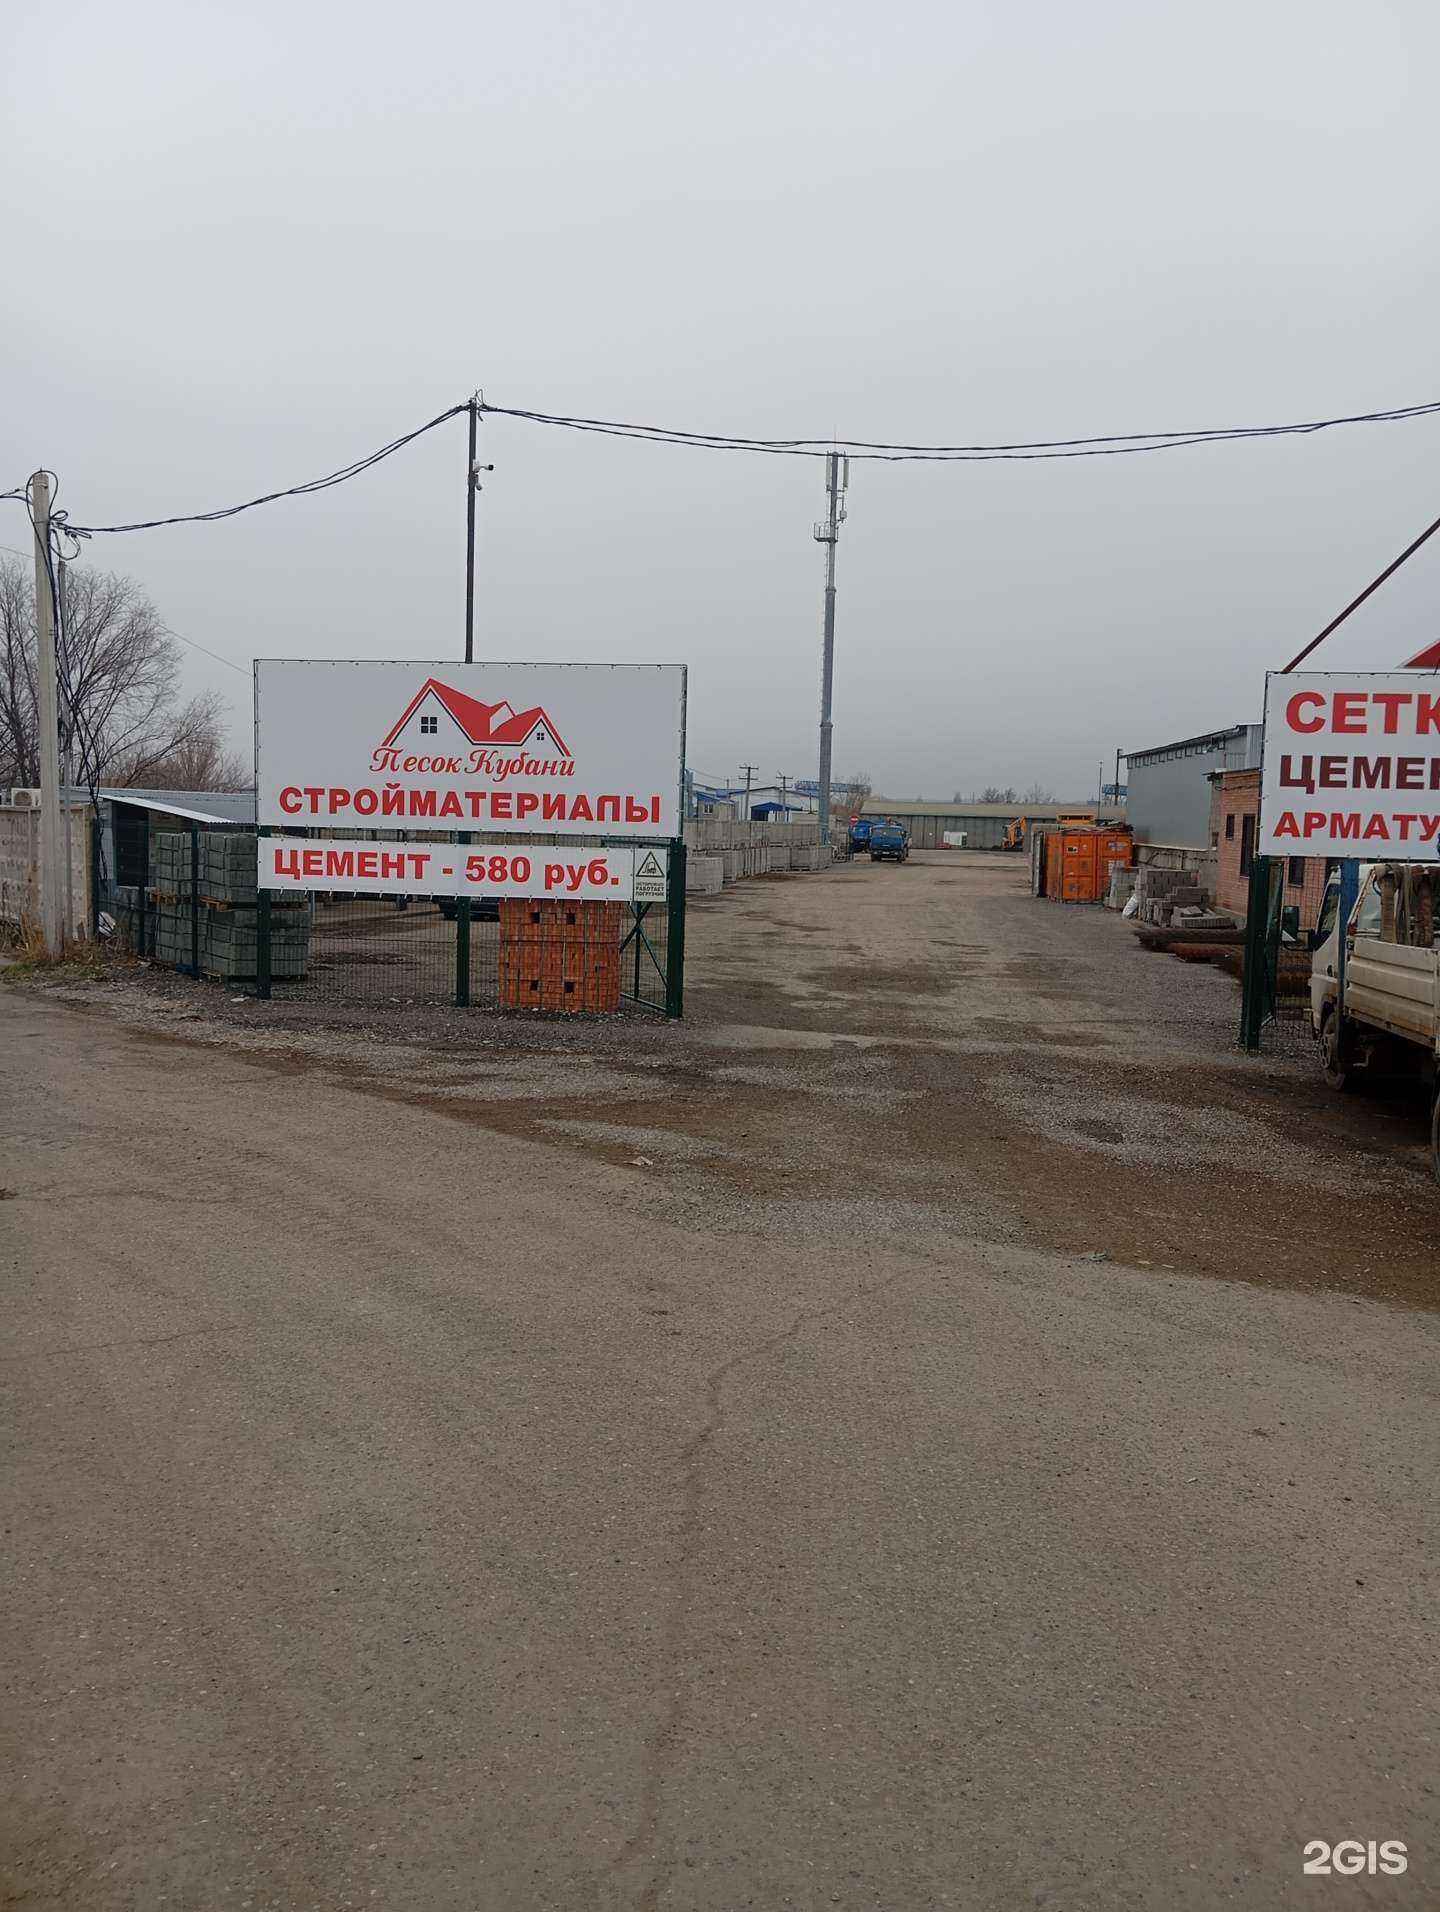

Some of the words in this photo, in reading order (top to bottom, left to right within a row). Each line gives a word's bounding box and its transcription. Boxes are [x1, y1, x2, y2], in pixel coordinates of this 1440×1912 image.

[1286, 691, 1440, 734] СЕТК
[369, 747, 461, 773] Песок
[465, 749, 575, 783] Кубани
[279, 783, 660, 823] СТРОЙМАТЕРИАЛЫ
[1273, 811, 1440, 841] АРМАТУ
[275, 849, 430, 880] ЦЕМЕНТ
[466, 855, 531, 882] 580
[544, 858, 619, 891] руб.
